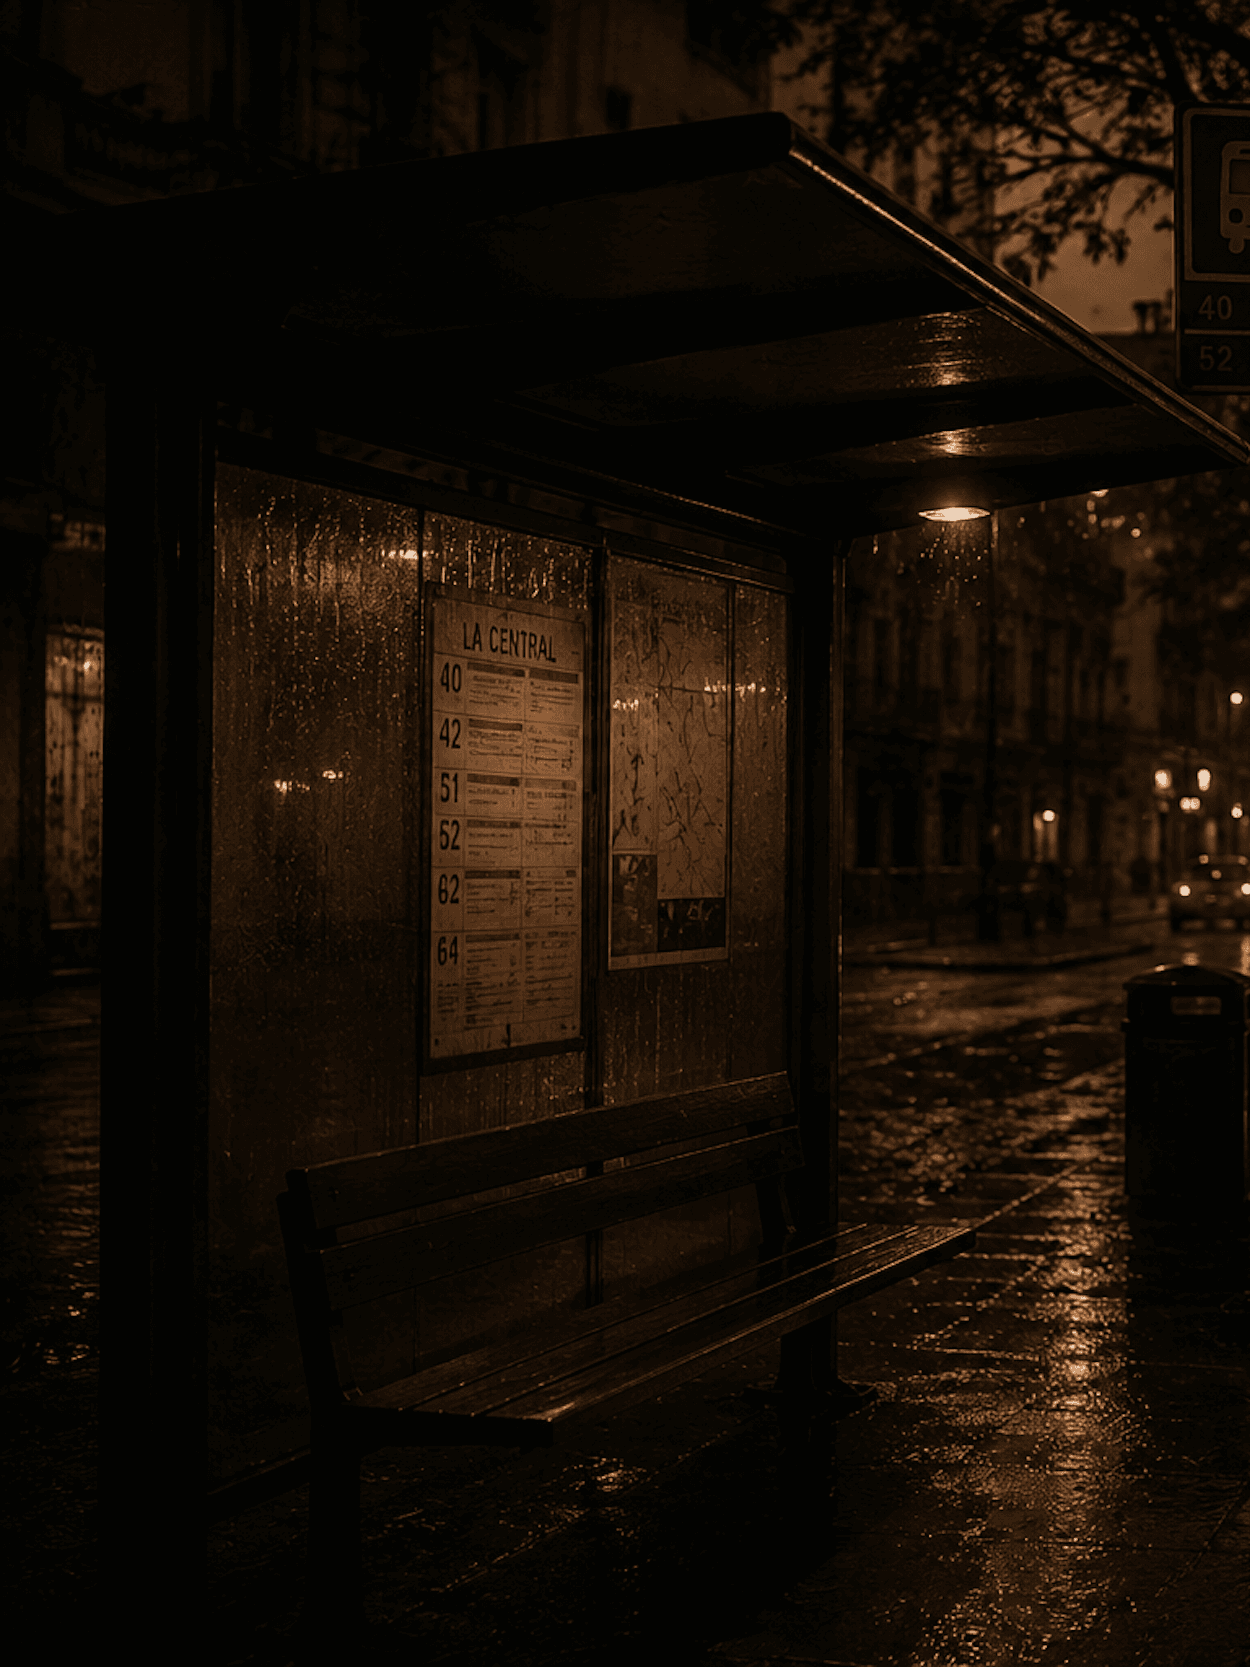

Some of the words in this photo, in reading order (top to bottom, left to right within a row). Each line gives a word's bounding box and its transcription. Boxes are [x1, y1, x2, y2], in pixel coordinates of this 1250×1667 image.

[1199, 295, 1233, 321] 40
[1199, 346, 1233, 372] 52
[463, 622, 482, 651] LA
[489, 625, 556, 662] CENTRAL
[441, 662, 462, 692] 40
[440, 718, 461, 749] 42
[441, 773, 459, 803] 51
[439, 820, 460, 850] 52
[438, 873, 459, 904] 62
[437, 936, 459, 965] 64
